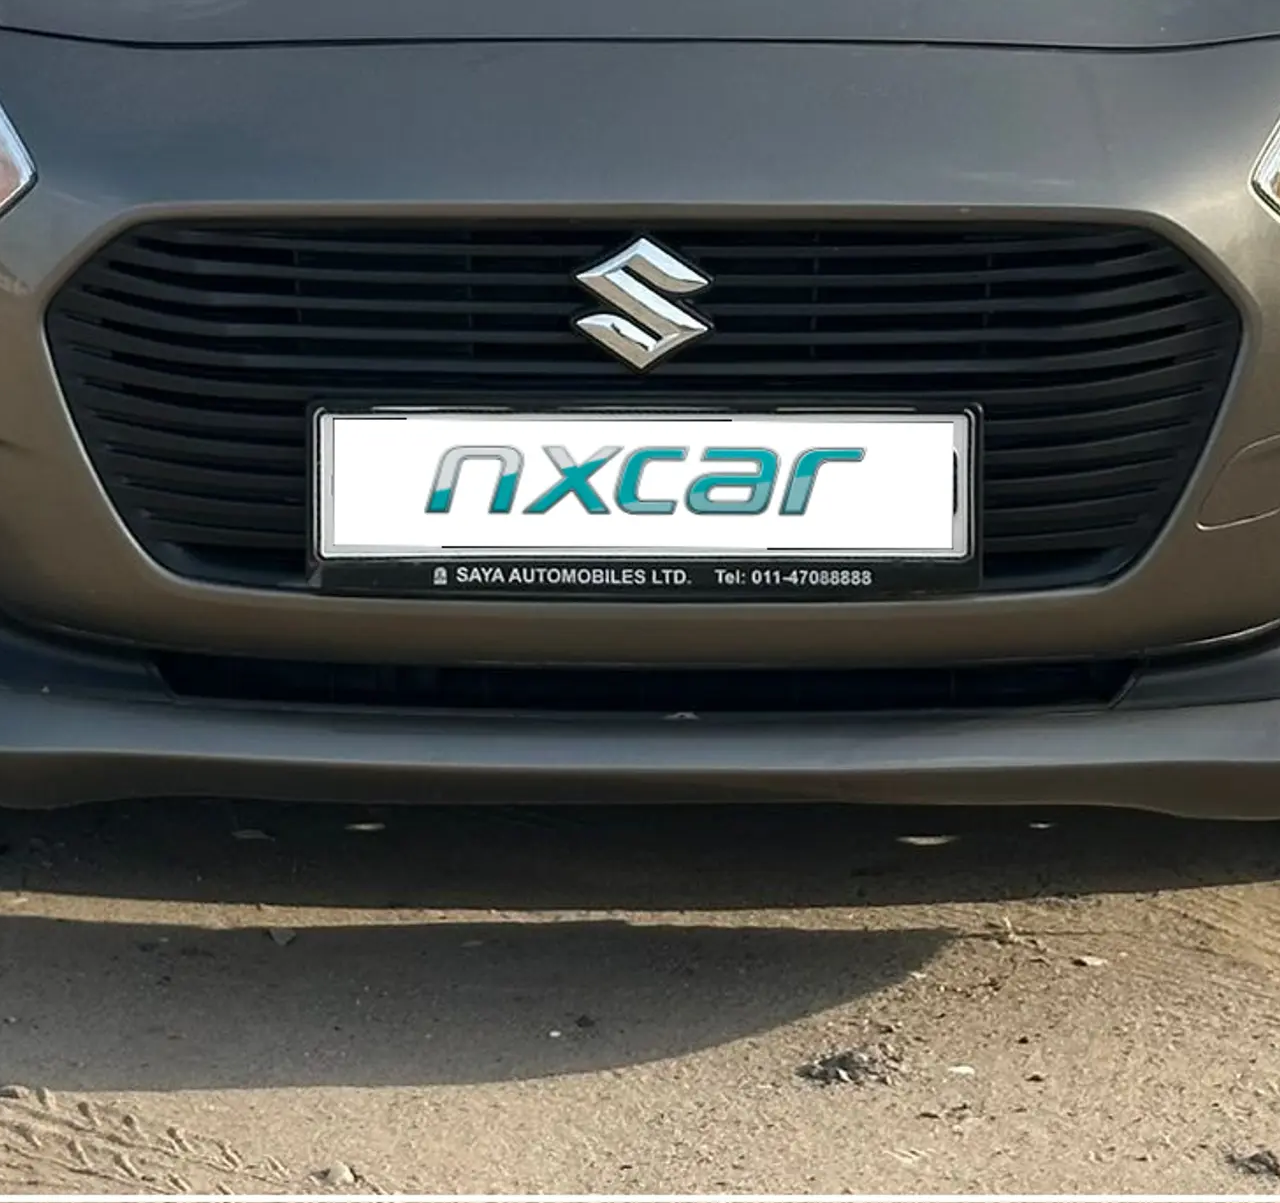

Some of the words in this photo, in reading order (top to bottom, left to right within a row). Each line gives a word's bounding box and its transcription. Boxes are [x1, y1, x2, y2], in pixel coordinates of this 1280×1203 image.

[456, 566, 505, 584] SAYA
[508, 567, 646, 585] AUTOMOBILES
[652, 569, 692, 585] LTD.
[715, 568, 746, 585] Tel:
[751, 569, 872, 586] 011-47088888
